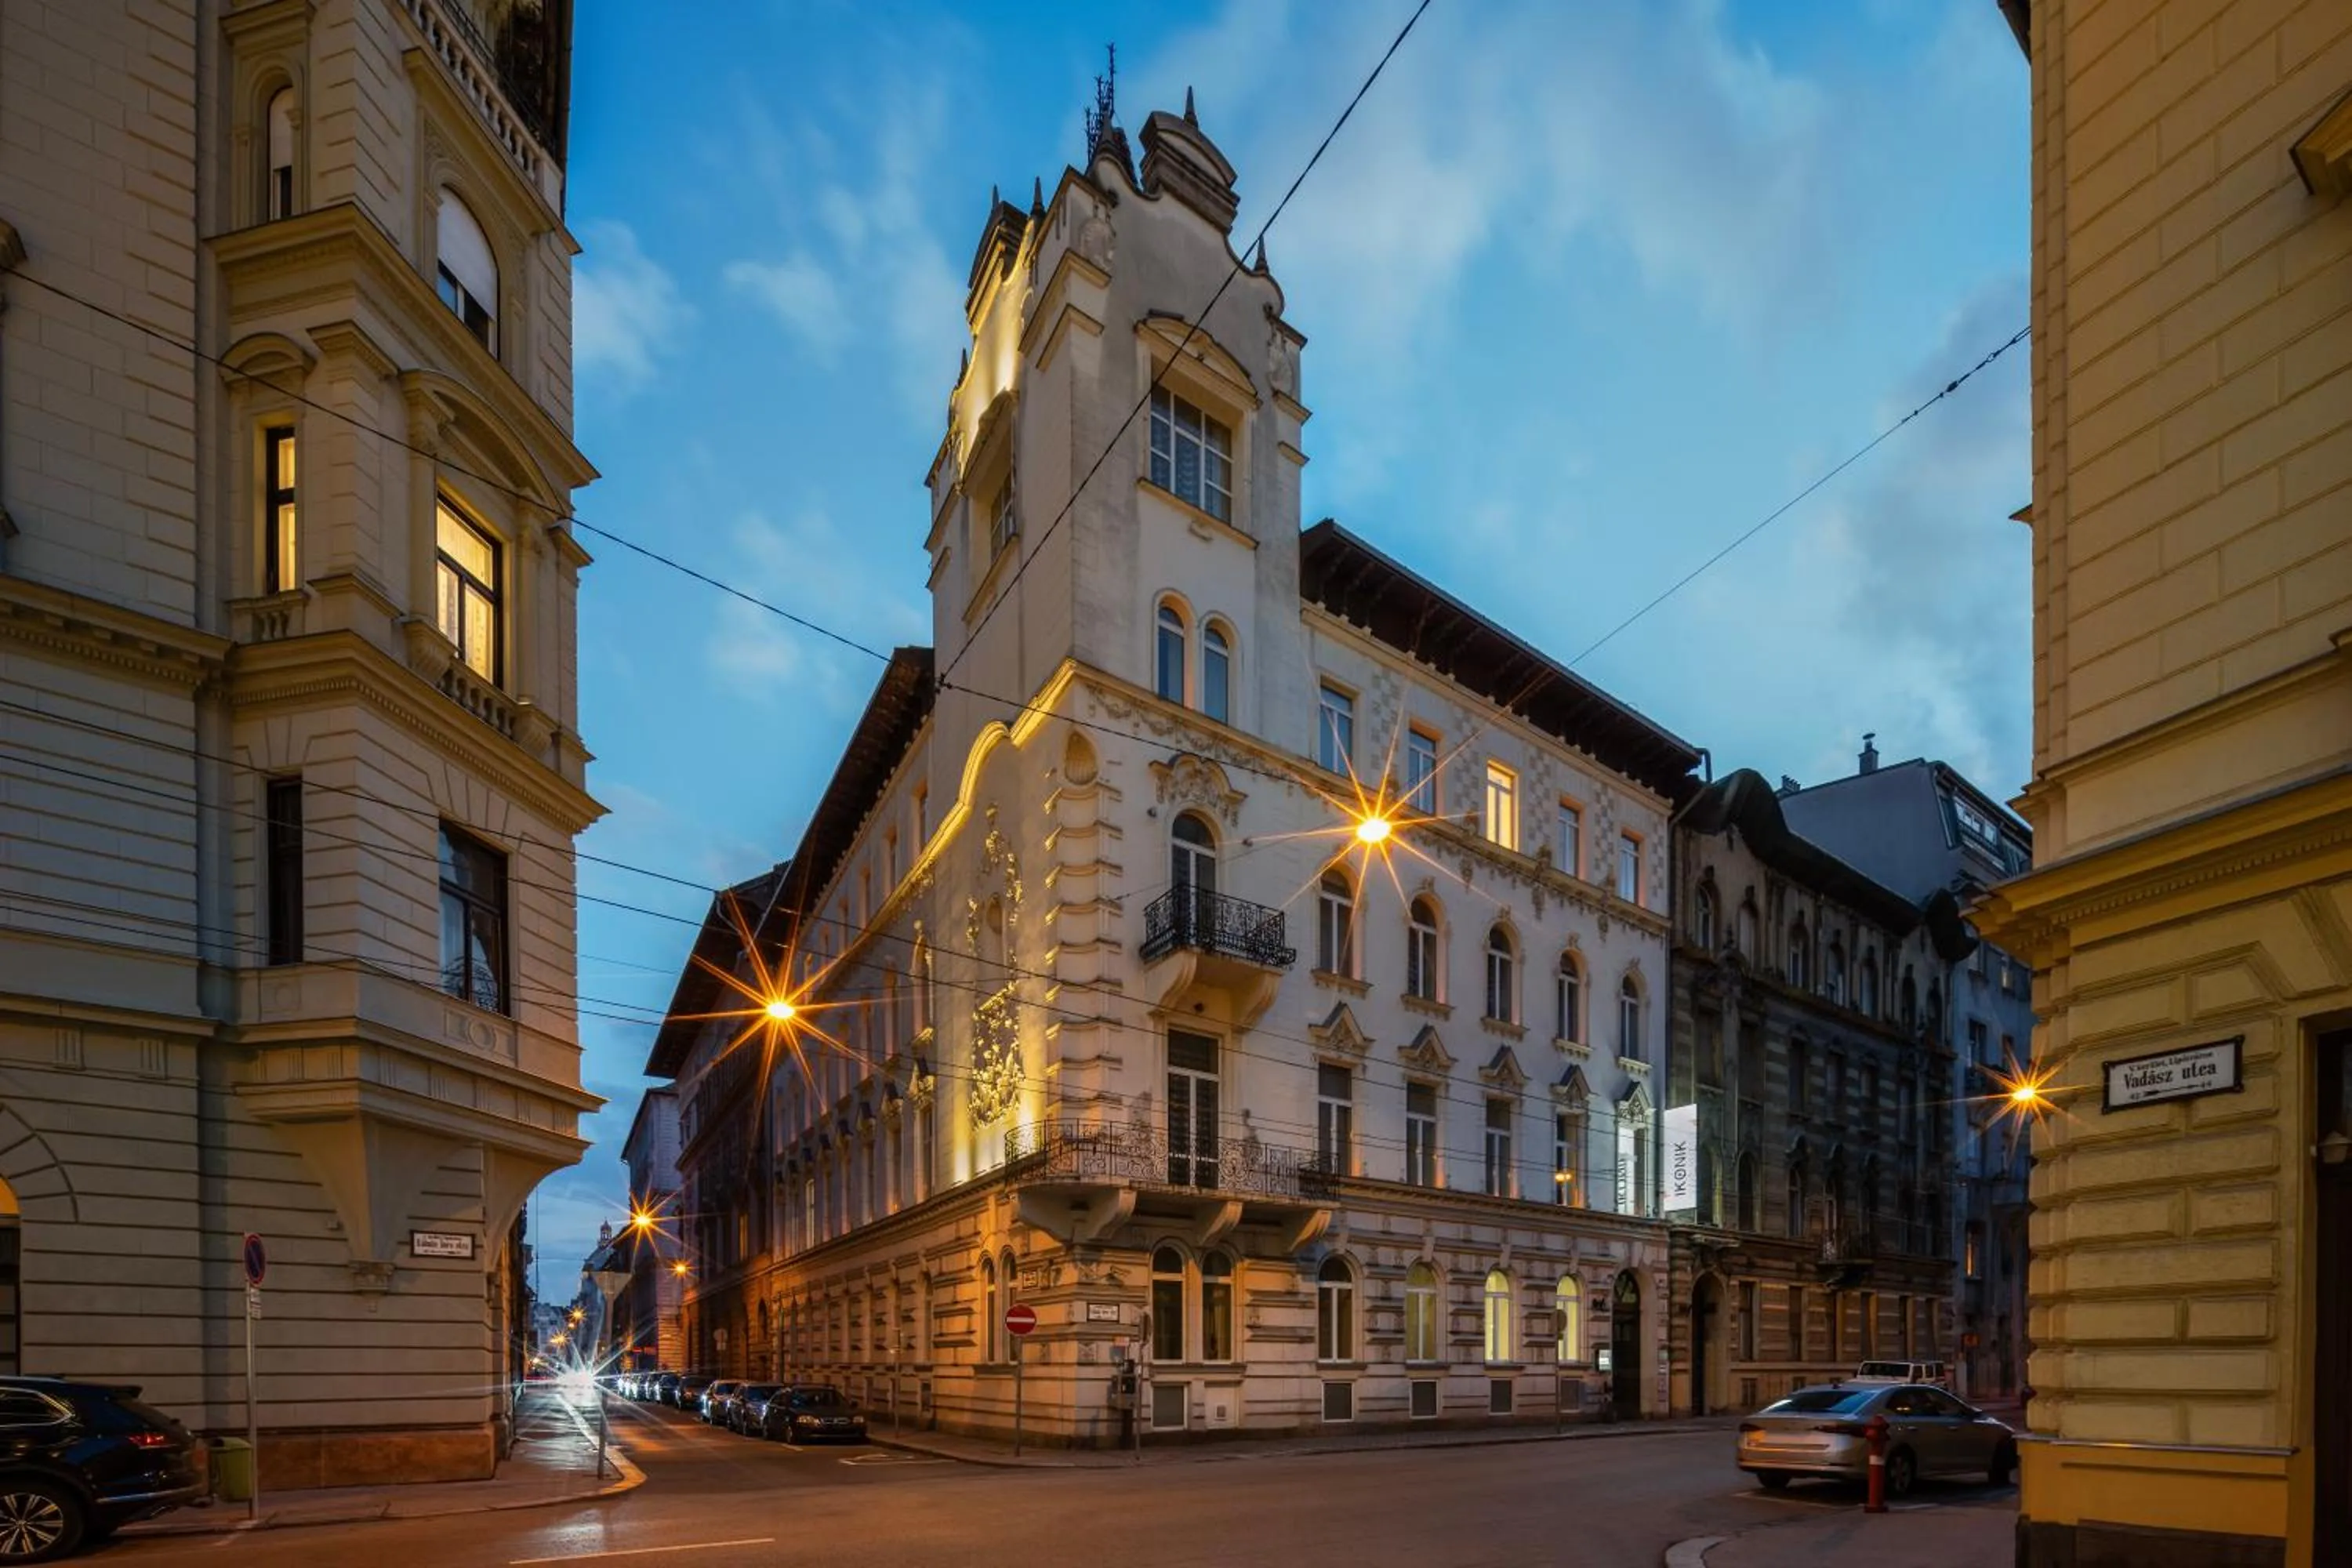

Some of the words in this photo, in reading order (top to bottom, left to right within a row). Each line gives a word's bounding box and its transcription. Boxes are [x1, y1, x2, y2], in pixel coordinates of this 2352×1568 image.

[2124, 1069, 2174, 1090] Vadász
[2182, 1062, 2217, 1080] utca
[1674, 1141, 1686, 1197] IKONIK
